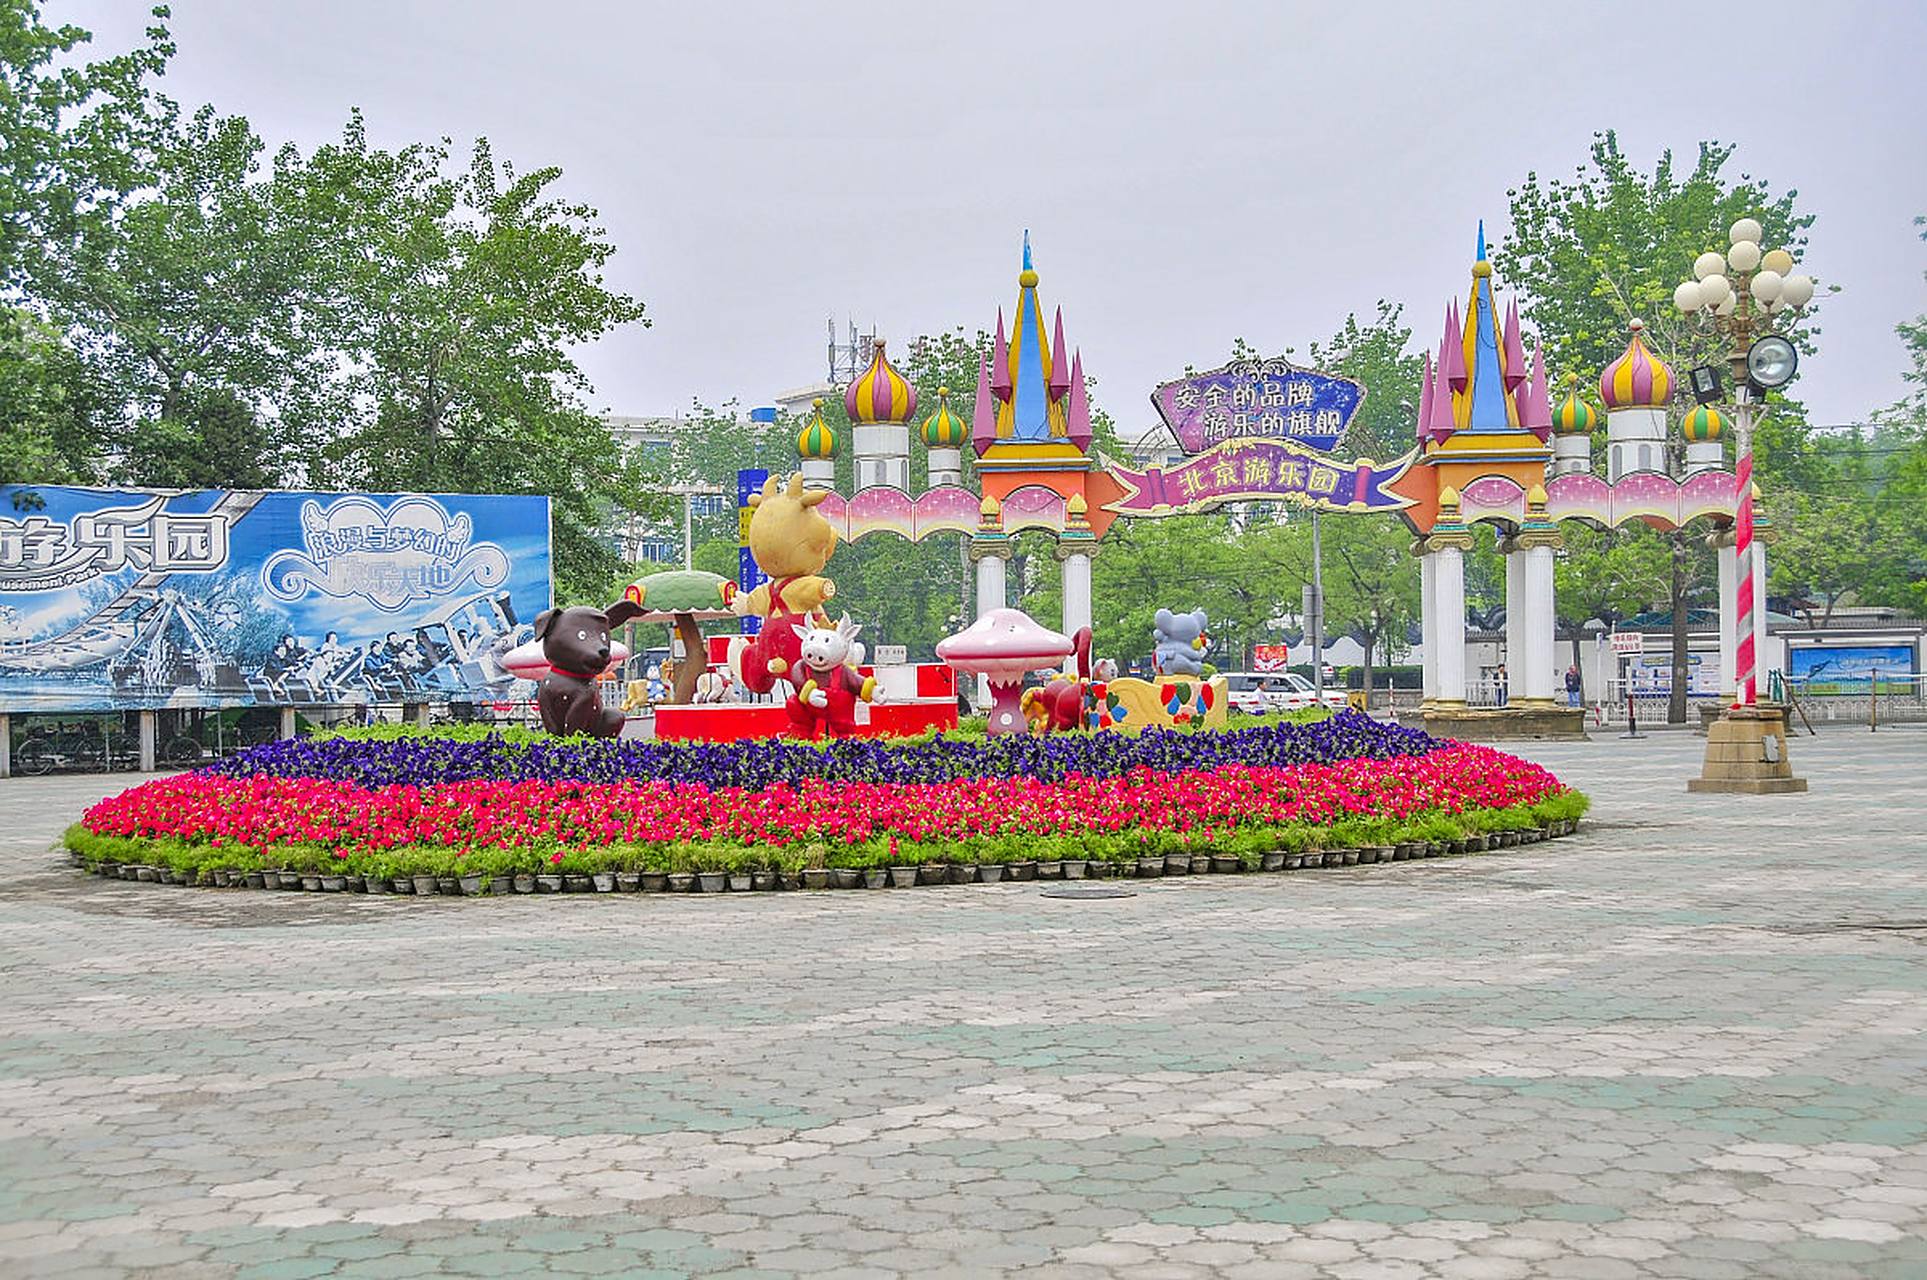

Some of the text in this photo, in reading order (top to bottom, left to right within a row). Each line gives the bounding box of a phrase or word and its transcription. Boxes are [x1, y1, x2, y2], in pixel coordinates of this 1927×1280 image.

[1175, 383, 1314, 408] 安全的品牌
[1204, 410, 1341, 436] 游乐的旗舰
[1180, 459, 1339, 495] 北京游乐园
[308, 525, 459, 562] 浪漫与梦幻的
[0, 565, 101, 591] usement Park
